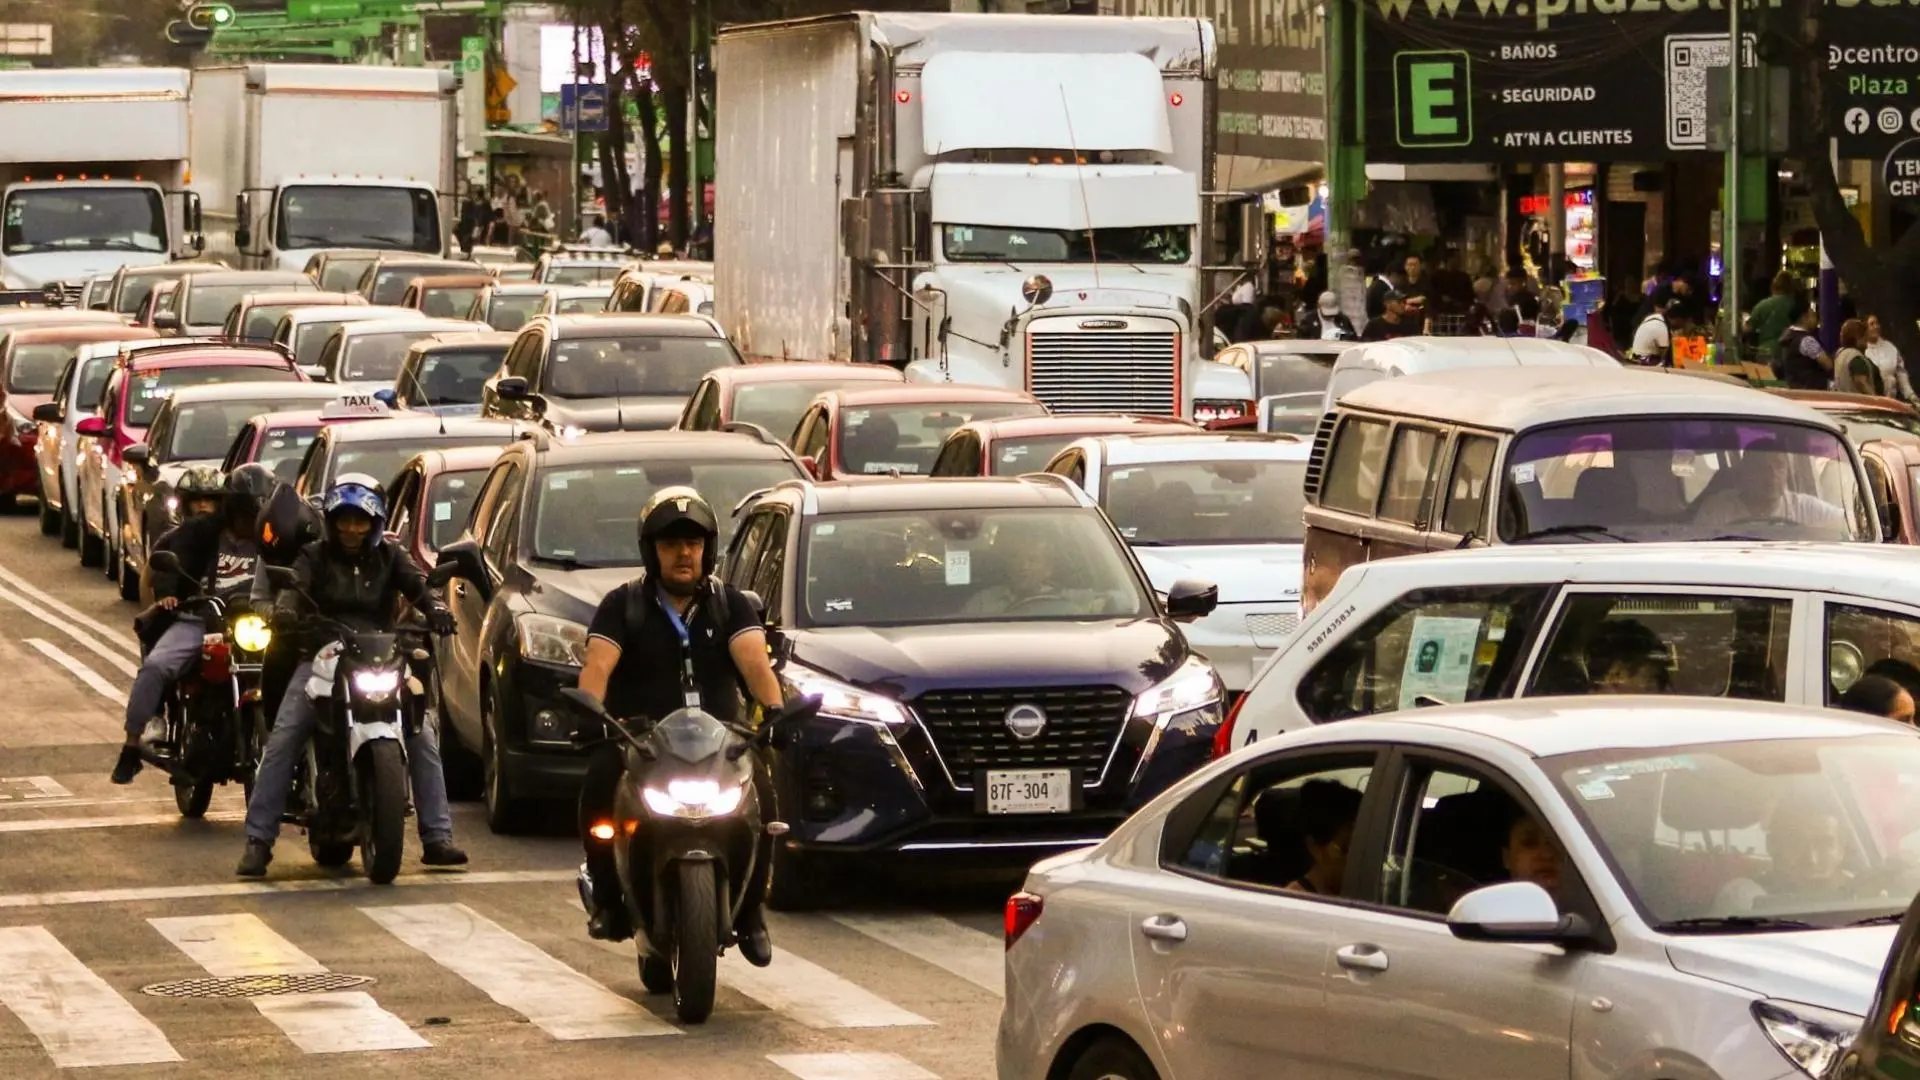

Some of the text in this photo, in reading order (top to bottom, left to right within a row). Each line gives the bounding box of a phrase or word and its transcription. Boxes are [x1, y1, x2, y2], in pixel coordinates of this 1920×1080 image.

[1501, 42, 1558, 60] BAÑOS
[1848, 73, 1909, 95] Plaza
[1410, 62, 1458, 135] E
[1502, 87, 1596, 103] SEGURIDAD
[1543, 132, 1555, 145] A
[1558, 130, 1633, 145] CLIENTES
[342, 396, 370, 407] TAXI
[990, 782, 1049, 801] 87F-304
